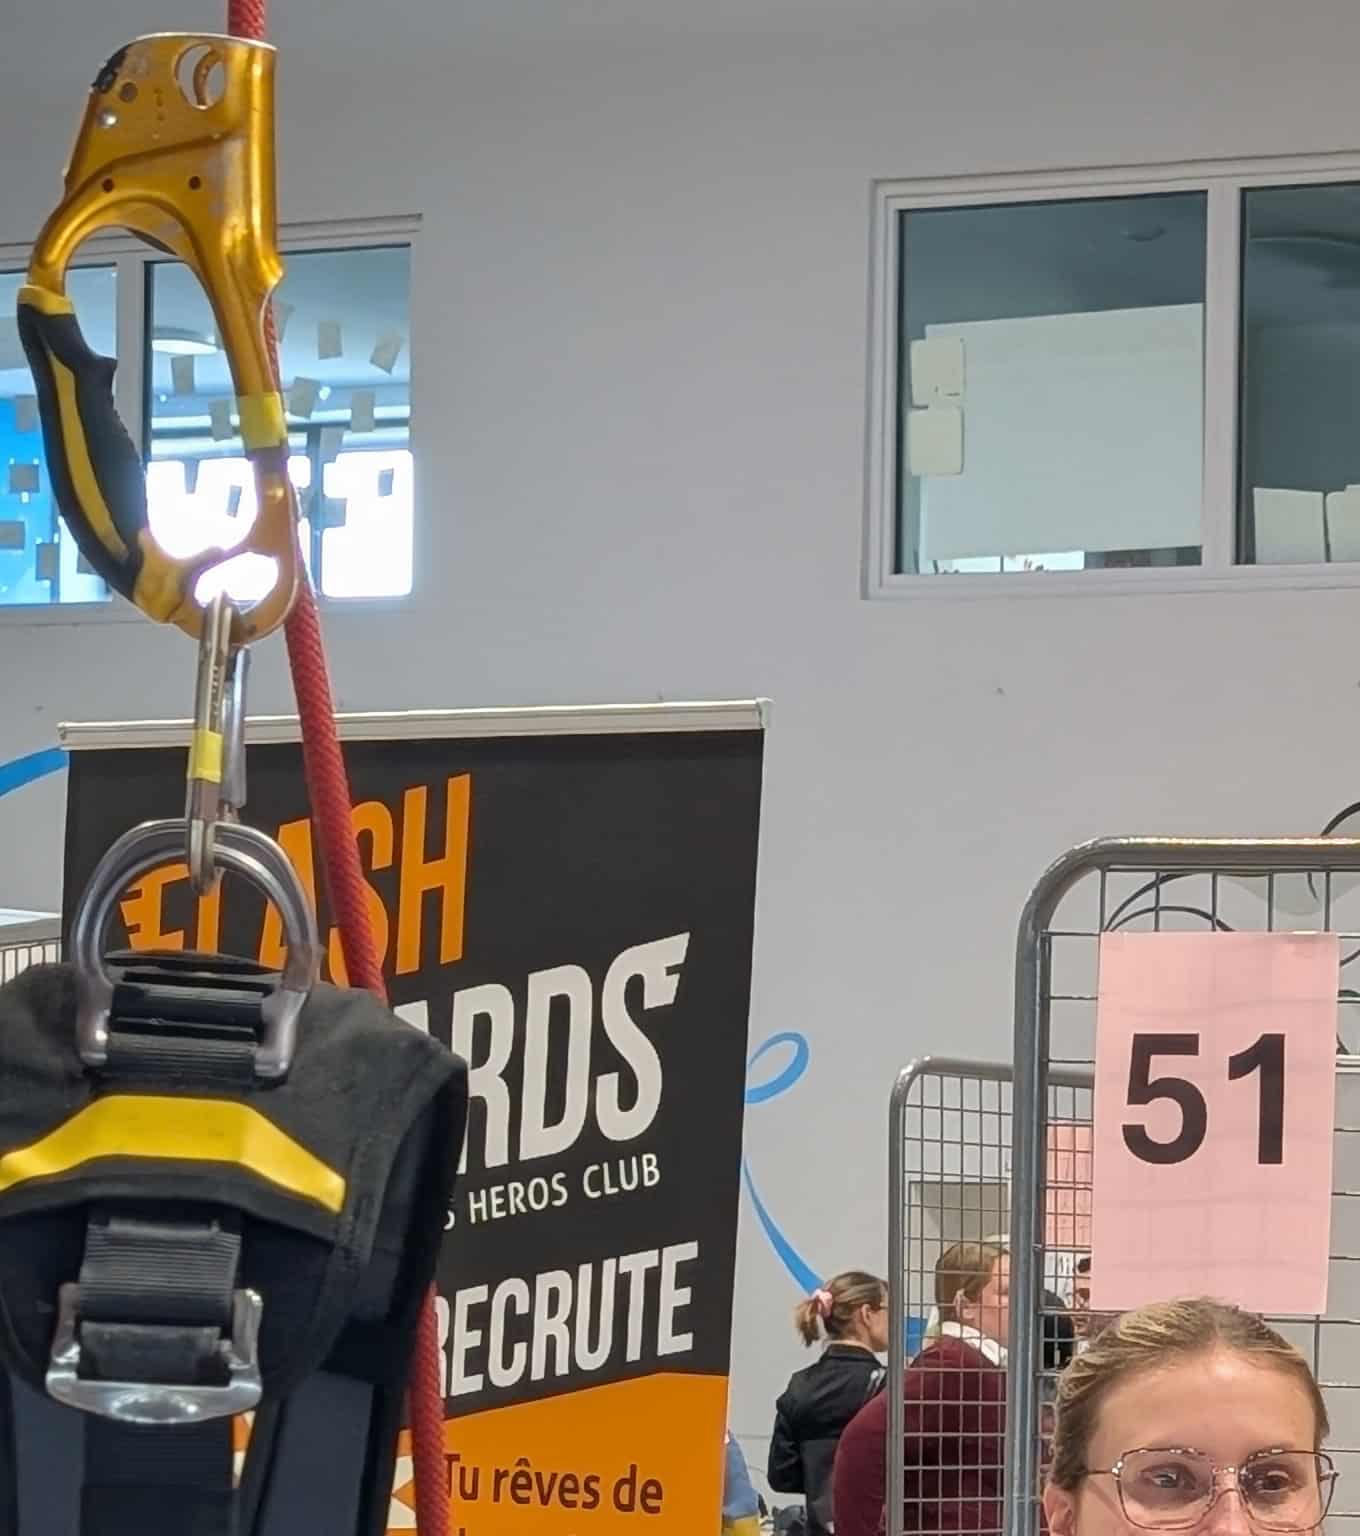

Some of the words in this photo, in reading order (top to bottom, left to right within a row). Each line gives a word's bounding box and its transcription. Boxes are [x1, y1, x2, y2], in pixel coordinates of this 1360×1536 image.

[1121, 1031, 1286, 1166] 51
[468, 1171, 568, 1224] HEROS
[582, 1152, 661, 1199] CLUB
[493, 1457, 601, 1509] rêves
[612, 1463, 664, 1515] de
